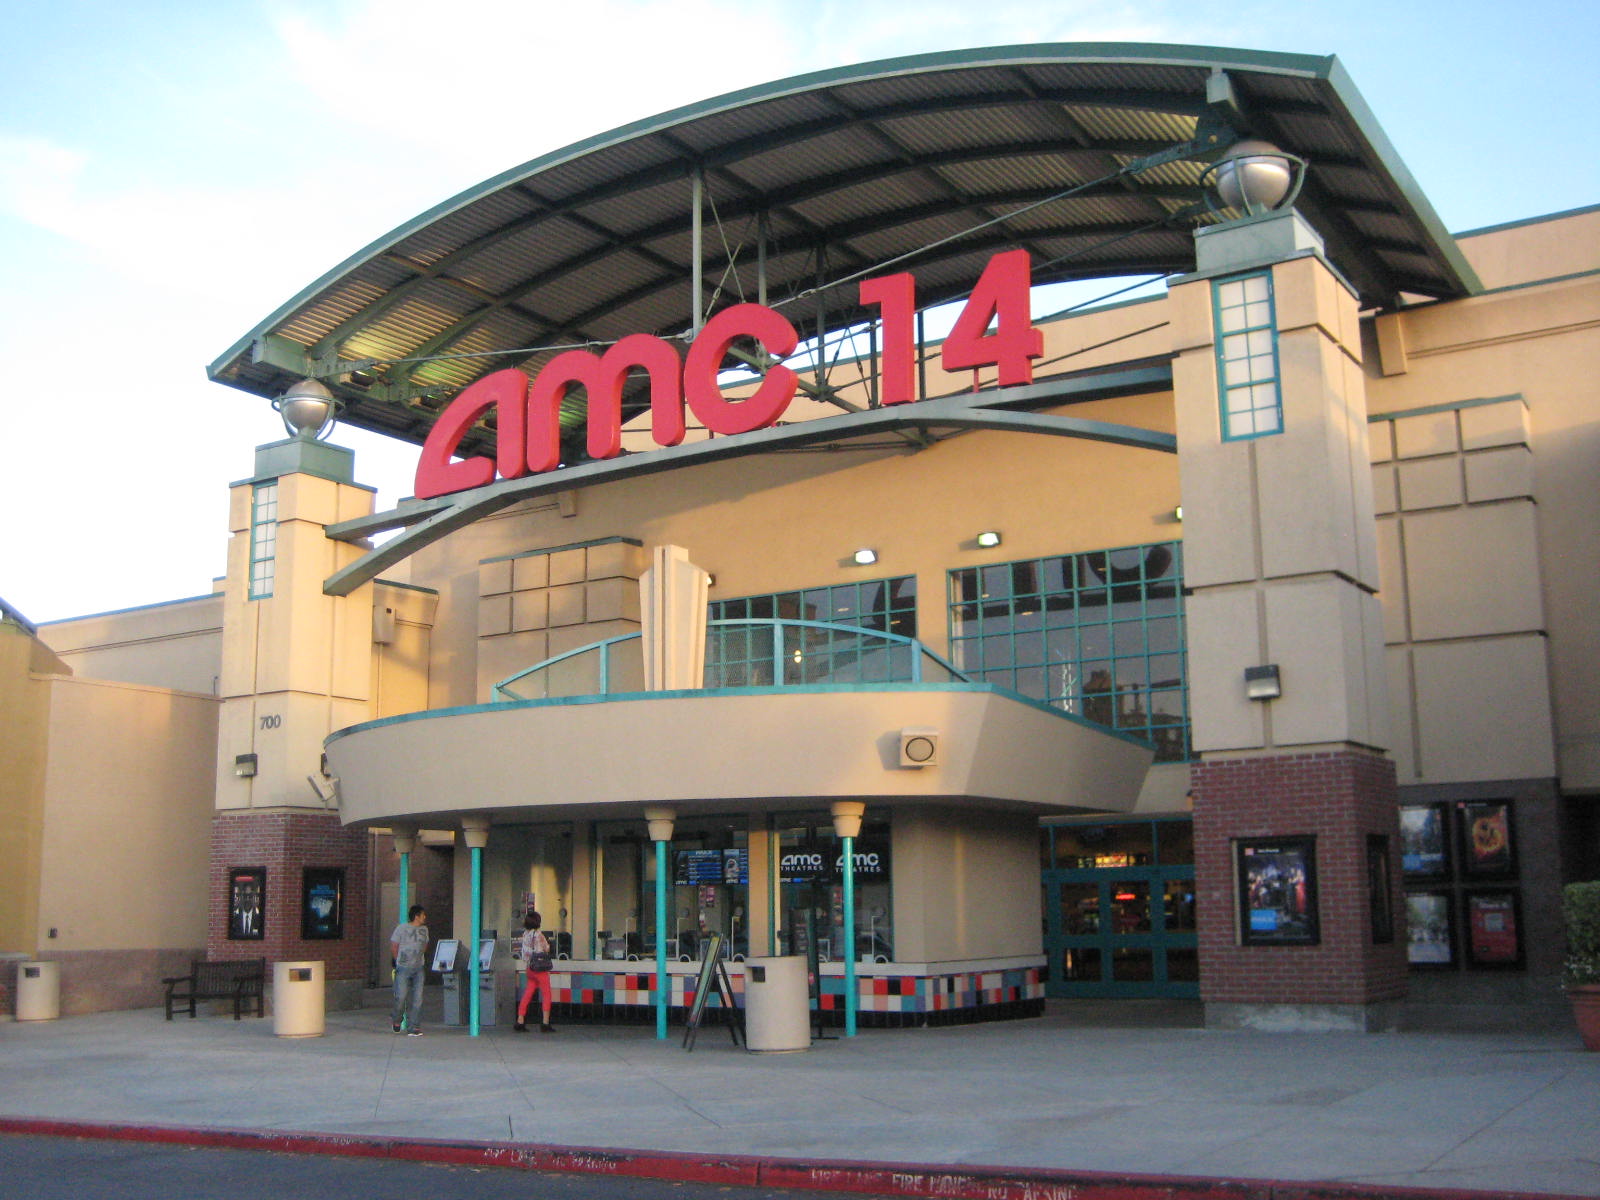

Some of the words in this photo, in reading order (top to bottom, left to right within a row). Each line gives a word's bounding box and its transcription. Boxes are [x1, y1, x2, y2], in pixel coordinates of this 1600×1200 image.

[859, 248, 1044, 406] 14
[259, 714, 282, 730] 700
[892, 1173, 923, 1191] FIRE
